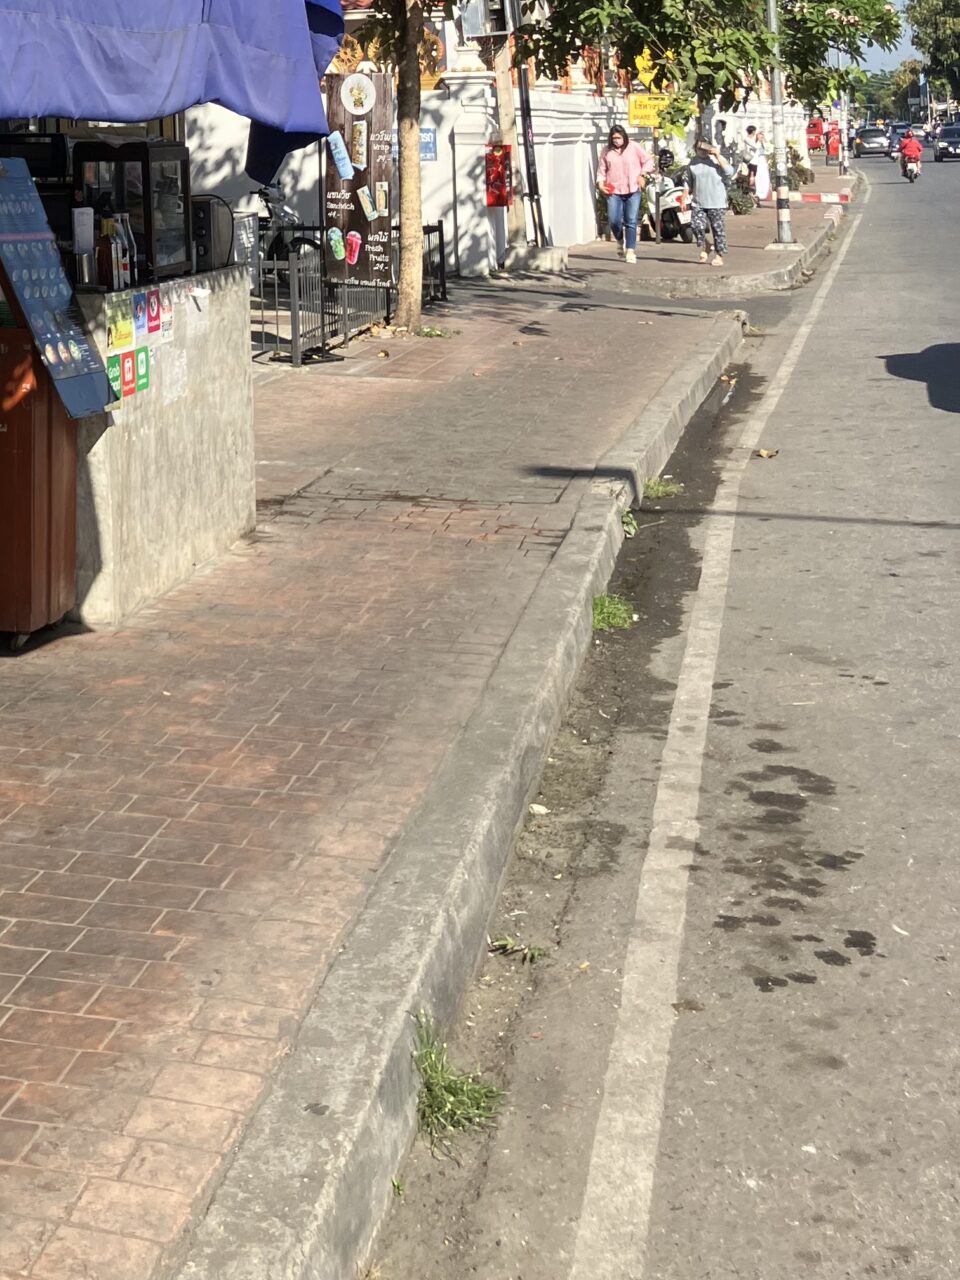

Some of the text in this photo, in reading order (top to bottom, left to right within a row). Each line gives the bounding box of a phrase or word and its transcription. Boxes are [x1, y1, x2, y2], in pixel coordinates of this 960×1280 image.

[373, 143, 390, 154] Wrap
[367, 231, 389, 243] ผลไม้
[365, 244, 384, 253] Fresh
[369, 253, 389, 262] Fruits
